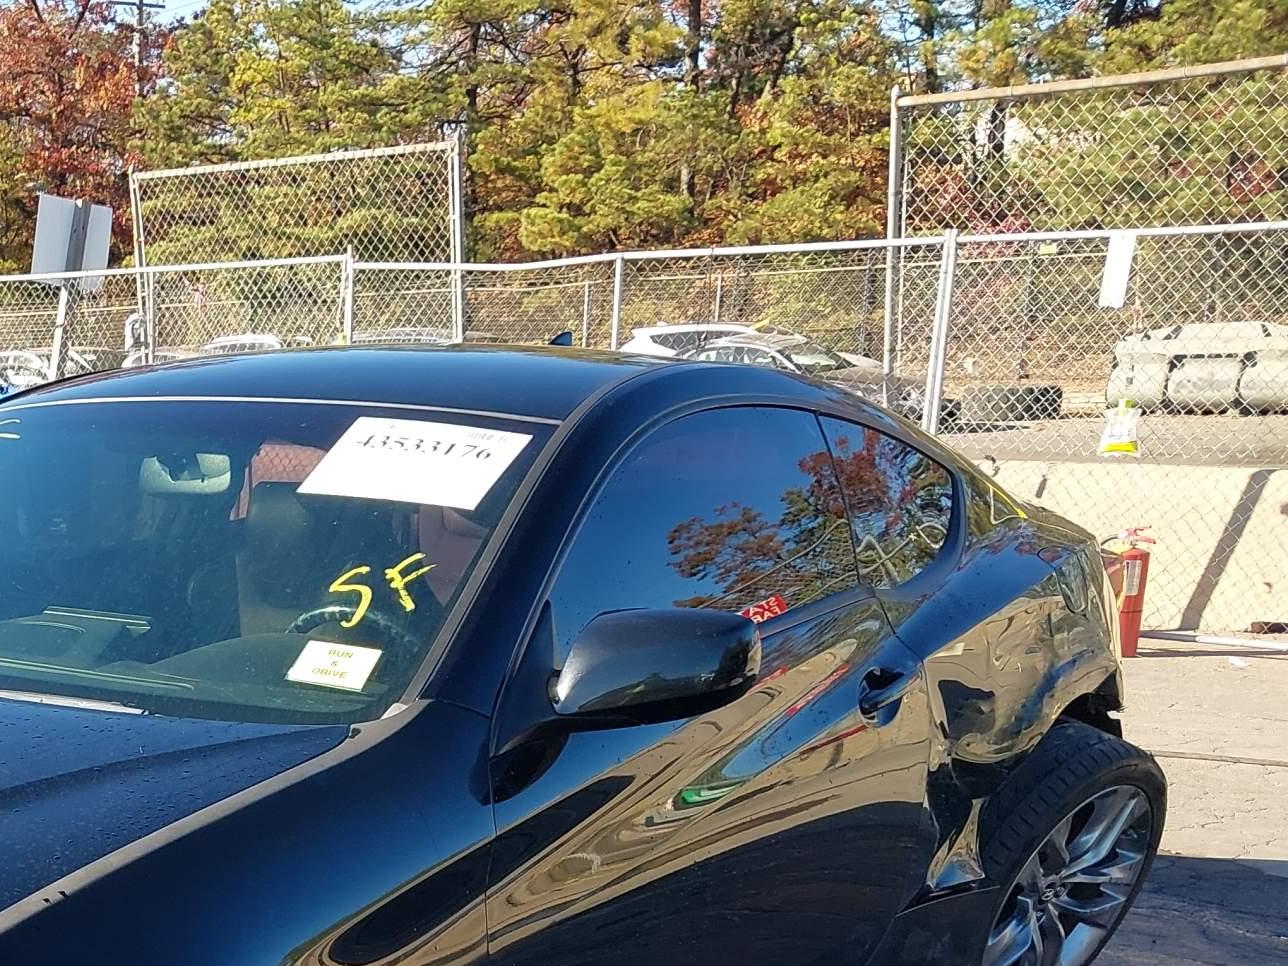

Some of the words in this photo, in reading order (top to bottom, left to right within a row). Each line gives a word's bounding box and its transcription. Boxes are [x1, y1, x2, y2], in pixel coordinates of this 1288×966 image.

[356, 433, 492, 460] 43533176
[327, 649, 354, 659] RUN
[311, 667, 349, 679] DRIVE
